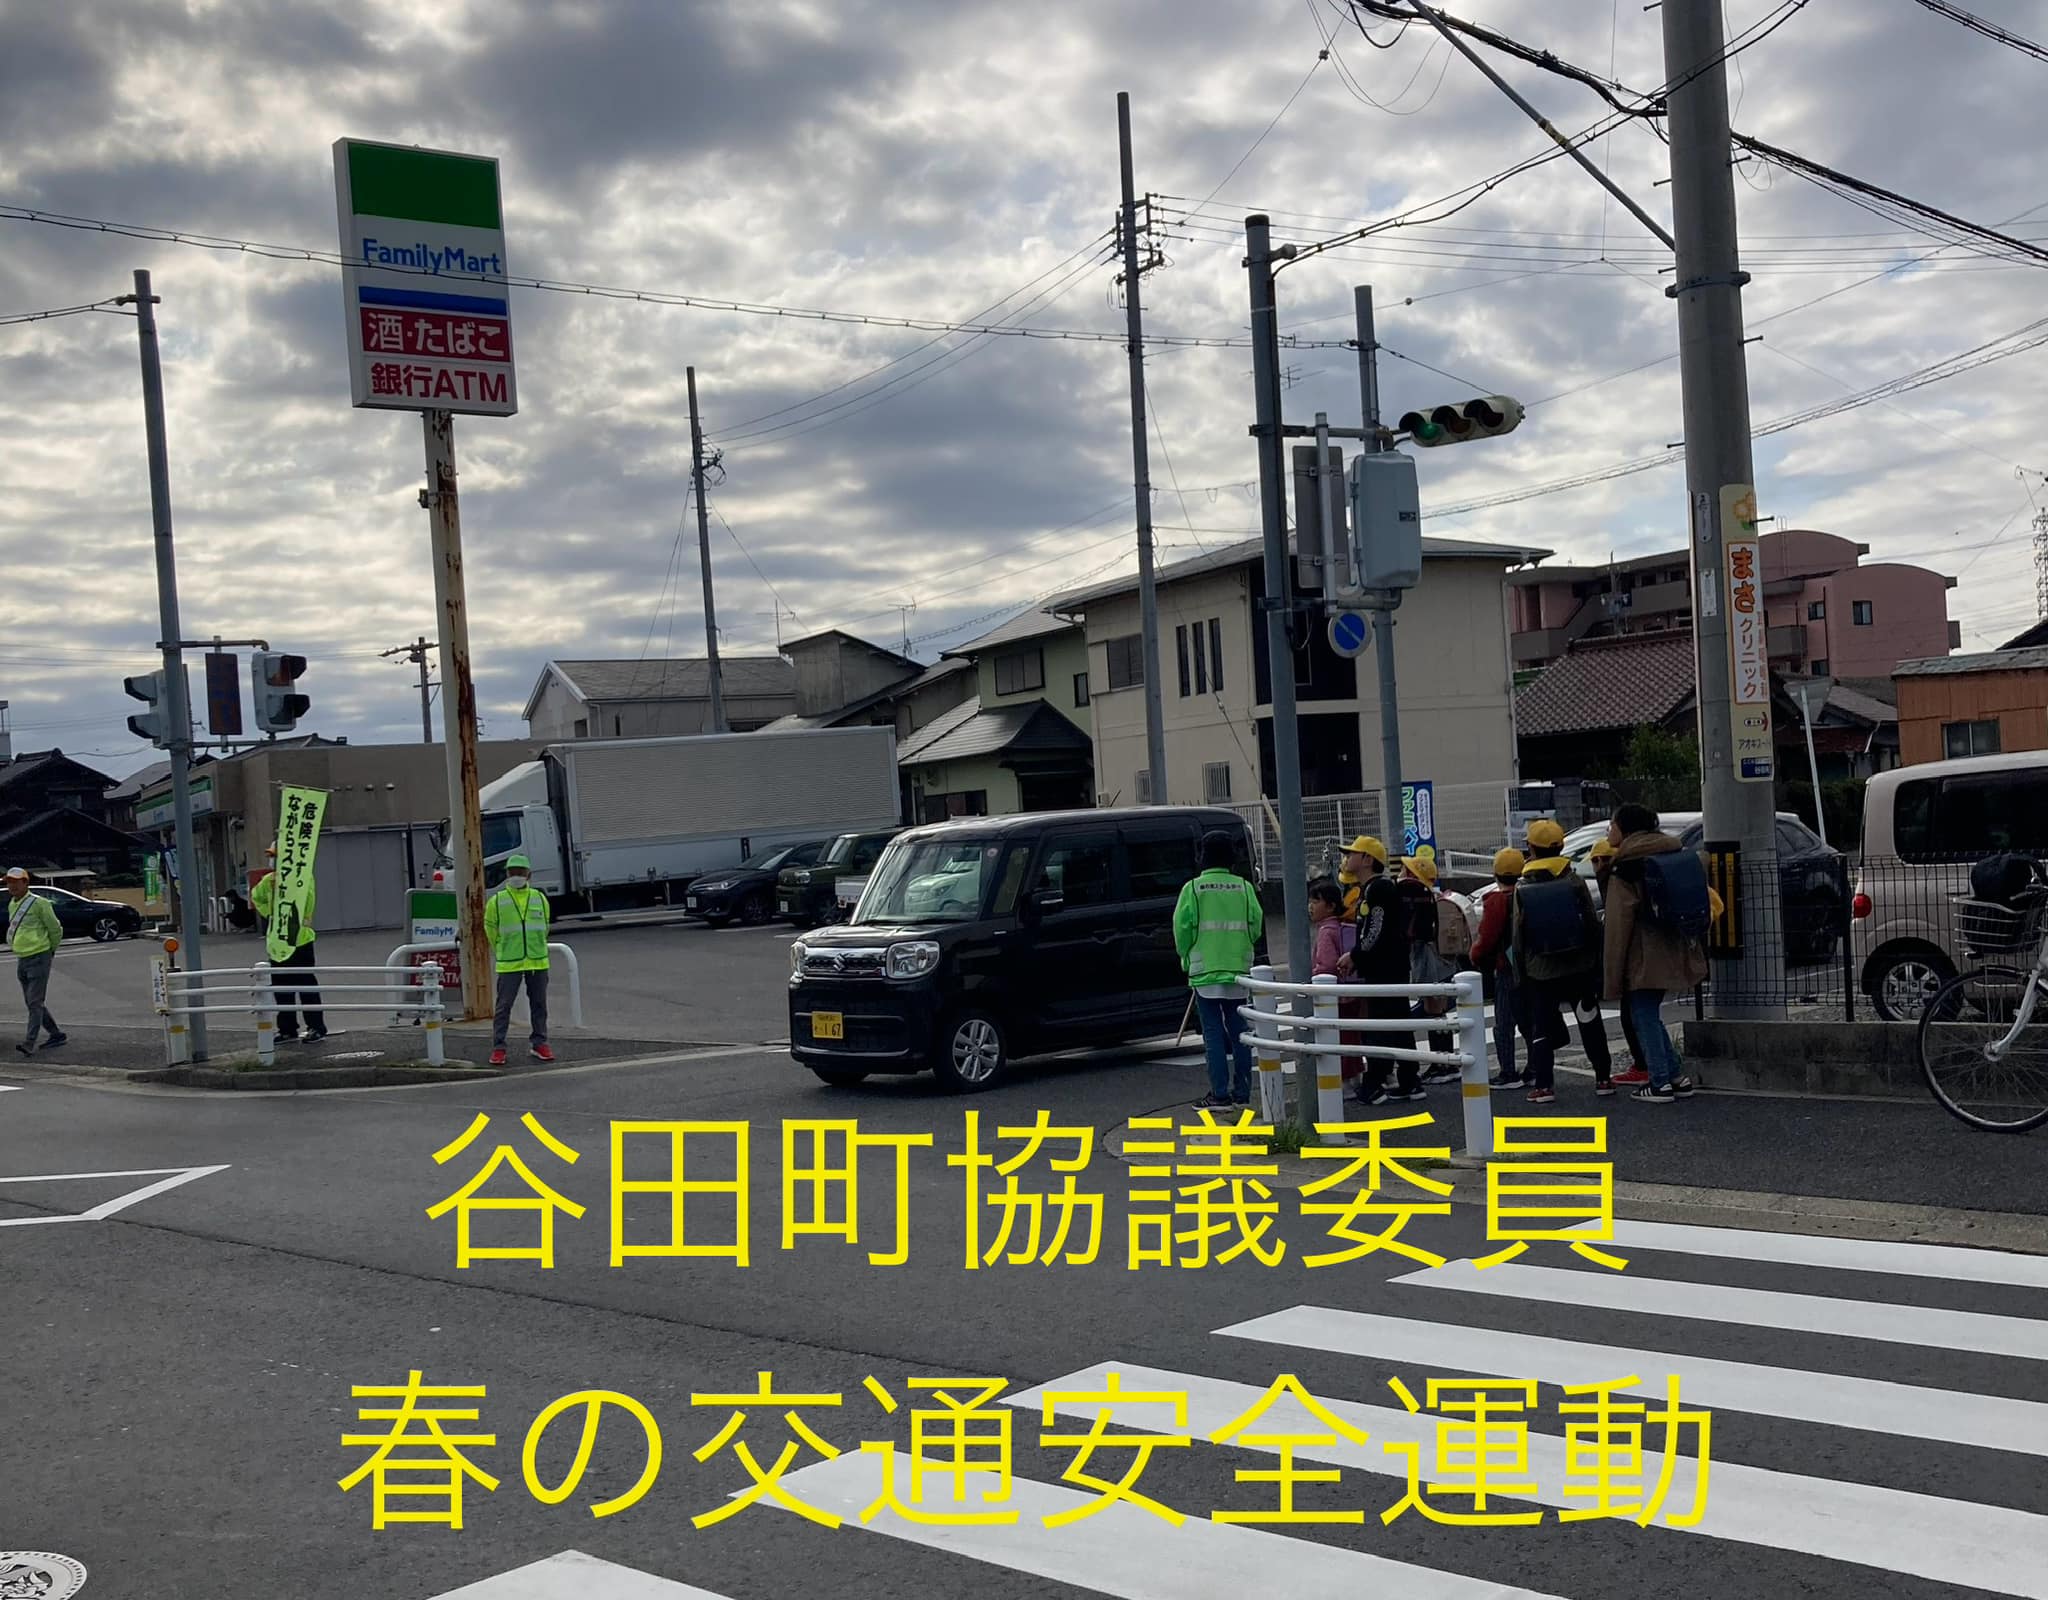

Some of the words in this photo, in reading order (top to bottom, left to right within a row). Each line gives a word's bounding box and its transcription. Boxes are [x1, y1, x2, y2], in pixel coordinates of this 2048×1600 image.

[362, 238, 501, 275] FamilyMart
[370, 362, 508, 403] 銀行ATM
[278, 794, 302, 899] ながらスマホ
